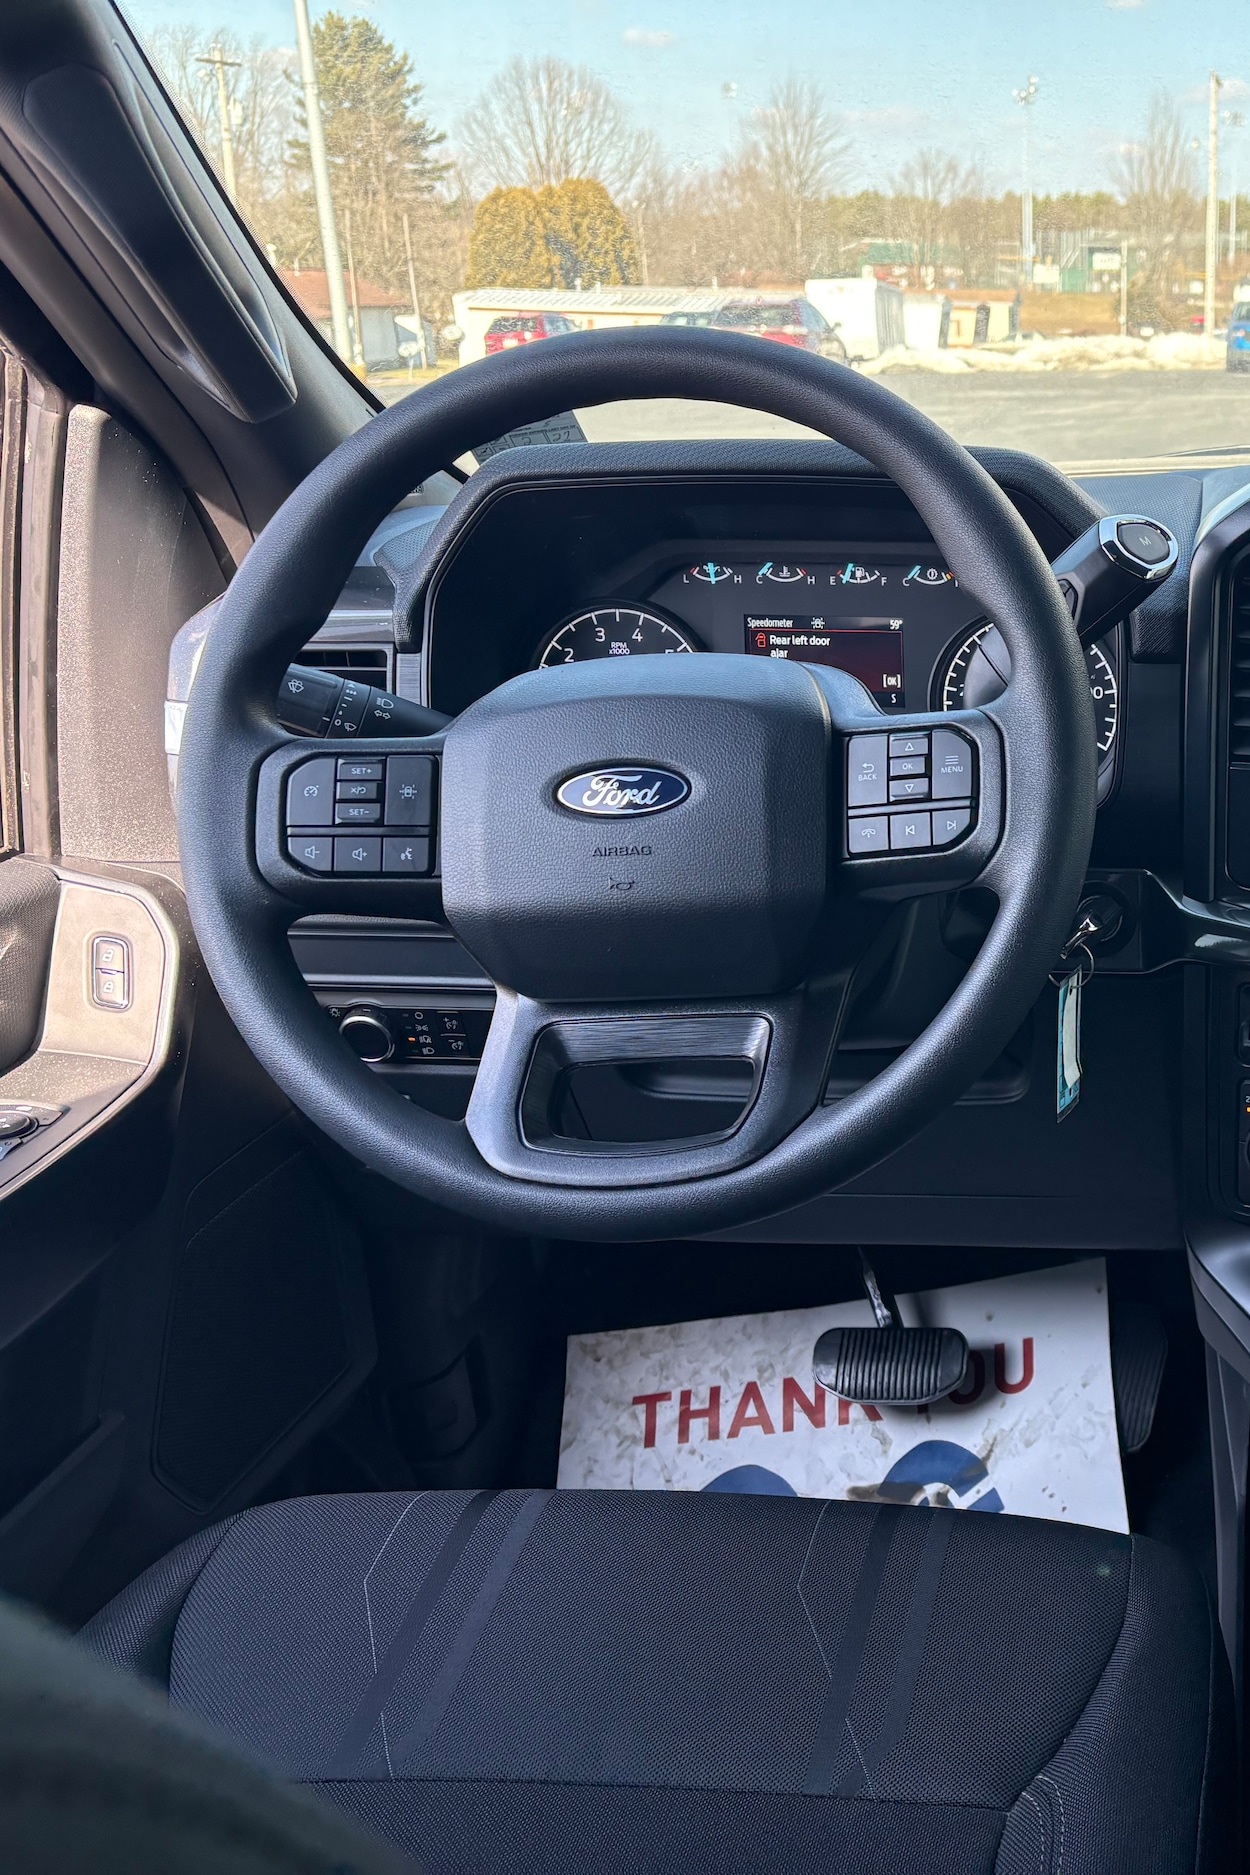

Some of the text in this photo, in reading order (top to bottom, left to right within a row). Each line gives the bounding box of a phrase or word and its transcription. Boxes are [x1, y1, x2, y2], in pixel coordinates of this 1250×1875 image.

[1139, 536, 1152, 546] M
[683, 575, 689, 584] L
[734, 576, 742, 584] H
[756, 575, 763, 584] C
[807, 576, 815, 585] H
[830, 577, 836, 585] E
[881, 577, 888, 586] F
[902, 578, 910, 587] C
[747, 617, 793, 628] Speedometer
[595, 627, 606, 642] 3
[631, 628, 643, 642] 4
[769, 634, 831, 646] Rear left door
[610, 641, 628, 649] RPM
[563, 648, 575, 663] 2
[902, 762, 914, 770] OK
[940, 766, 964, 774] MENU
[351, 767, 372, 775] SET+
[858, 773, 878, 782] BACK
[582, 774, 663, 807] Ford
[592, 845, 652, 857] AIRBAG
